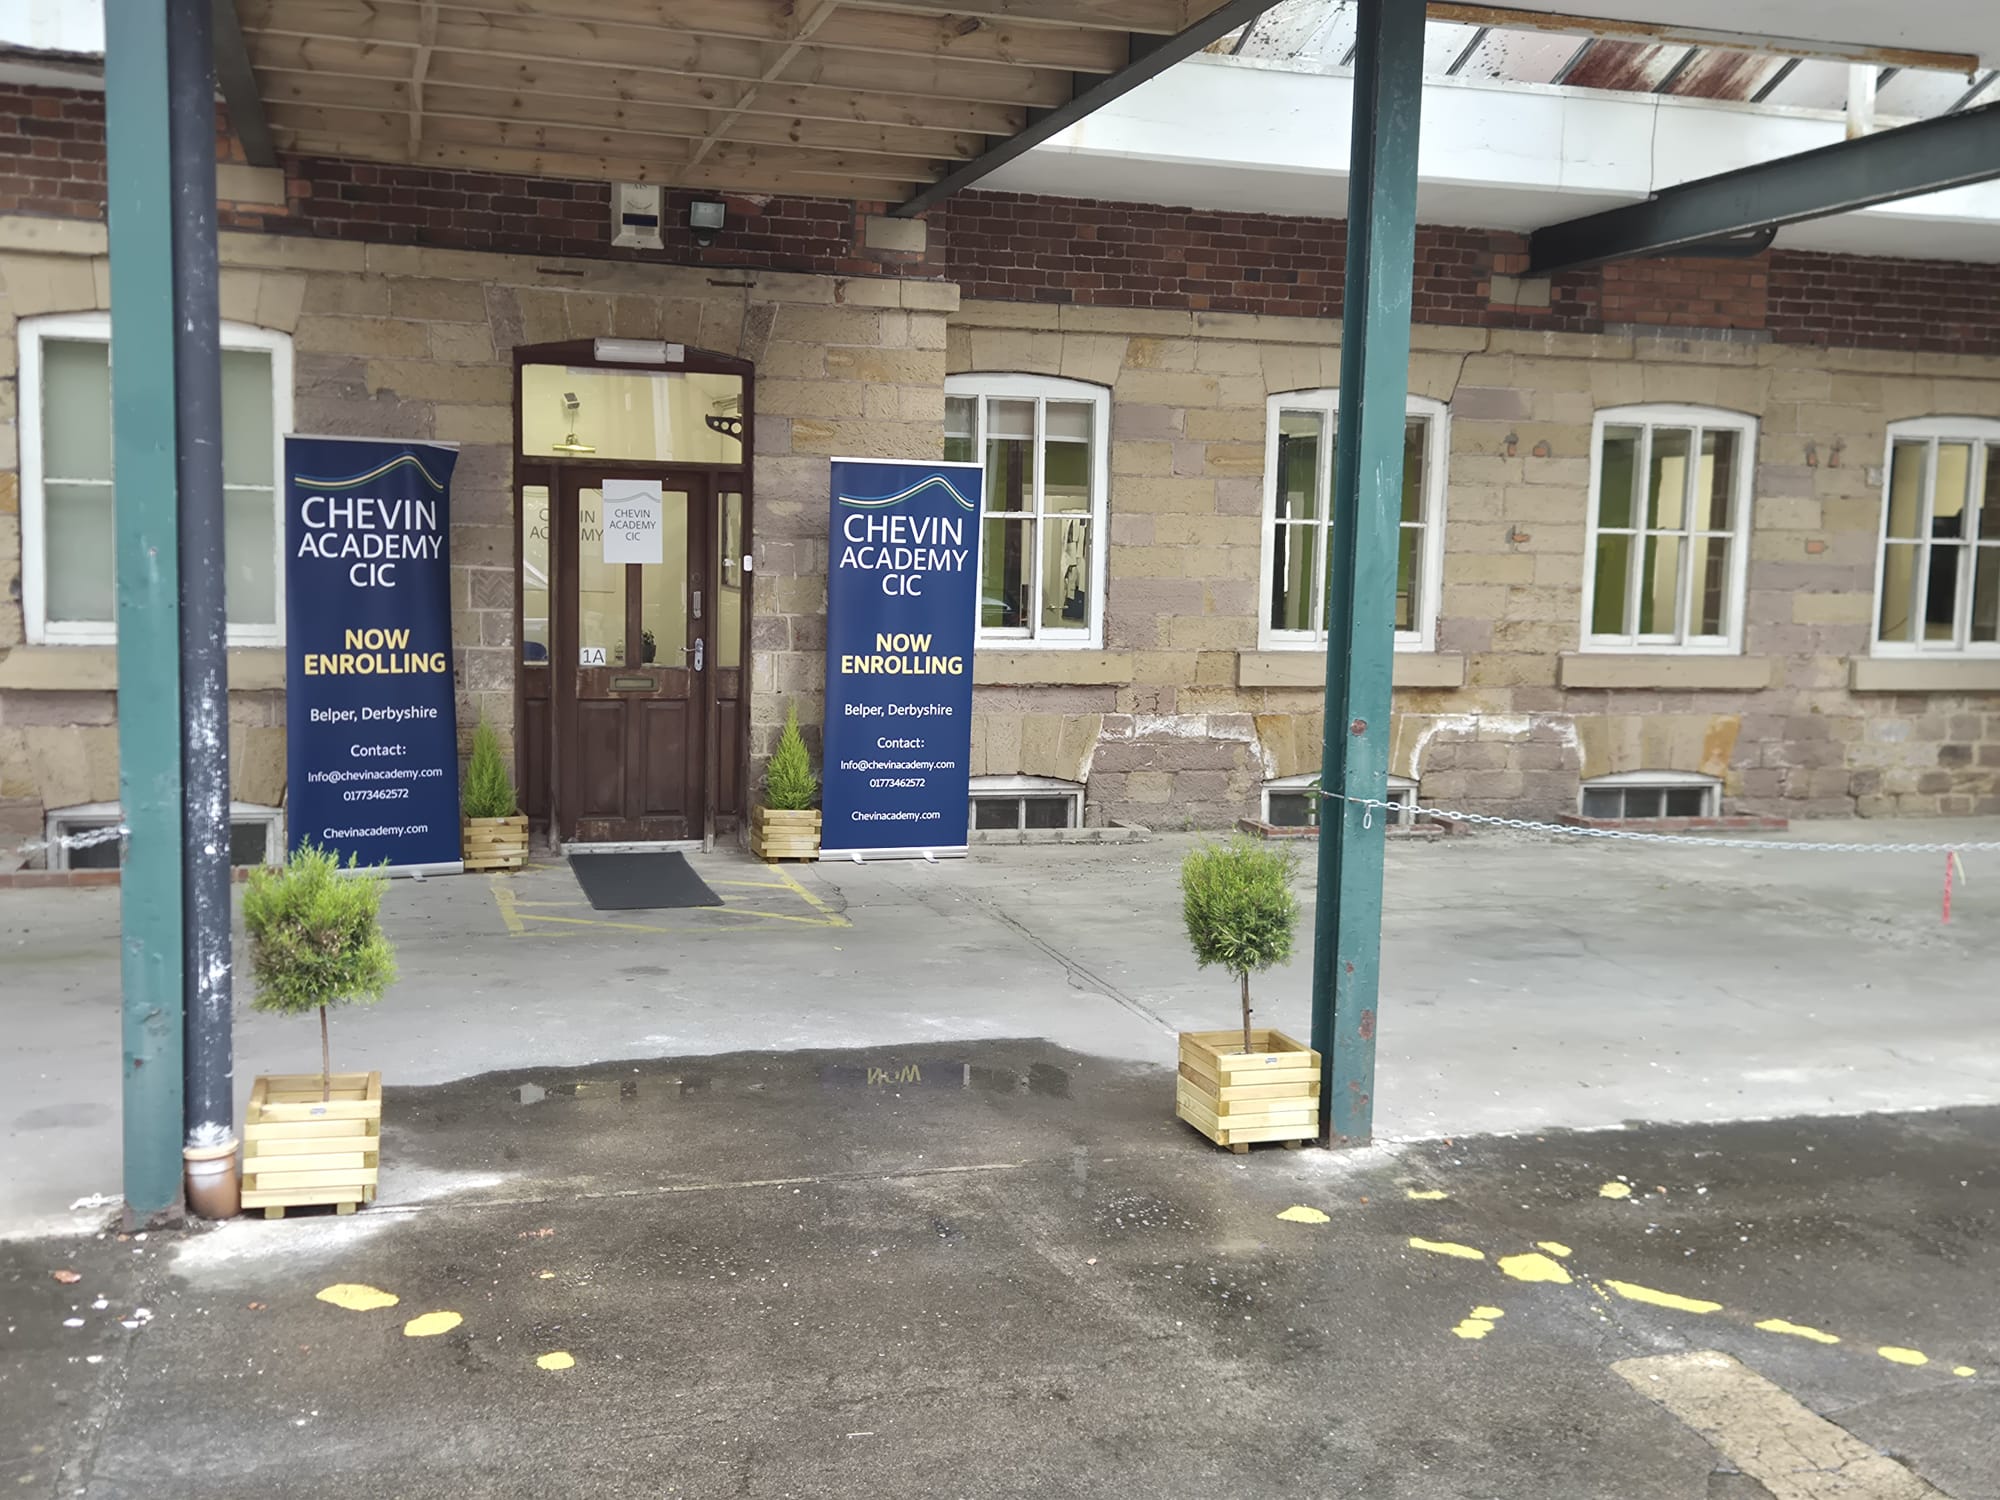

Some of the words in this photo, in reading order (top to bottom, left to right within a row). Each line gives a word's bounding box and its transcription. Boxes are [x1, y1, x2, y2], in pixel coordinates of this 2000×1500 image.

[301, 496, 437, 531] CHEVIN
[614, 508, 651, 518] CHEVIN
[609, 520, 656, 530] ACADEMY
[843, 513, 963, 546] CHEVIN
[625, 531, 641, 541] CIC
[297, 532, 443, 559] ACADEMY
[839, 546, 969, 572] ACADEMY
[349, 563, 396, 588] CIC
[882, 573, 922, 596] CIC
[345, 628, 410, 650] NOW
[876, 633, 932, 653] NOW
[304, 652, 446, 676] ENROLLING
[583, 649, 604, 663] 1A
[841, 655, 963, 675] ENROLLING
[310, 707, 358, 724] Belper,
[361, 705, 438, 724] Derbyshire
[844, 704, 885, 718] Belper,
[888, 703, 953, 719] Derbyshire
[350, 744, 407, 758] Contact:
[876, 736, 925, 749] Contact:
[840, 759, 955, 772] Info@chevinacademy.com
[308, 767, 443, 784] Info@chevinacademy.com
[869, 778, 926, 788] 01773462572
[343, 788, 409, 802] 01773462572
[851, 810, 941, 822] Chevinacademy.com
[323, 823, 428, 840] Chevinacademy.com
